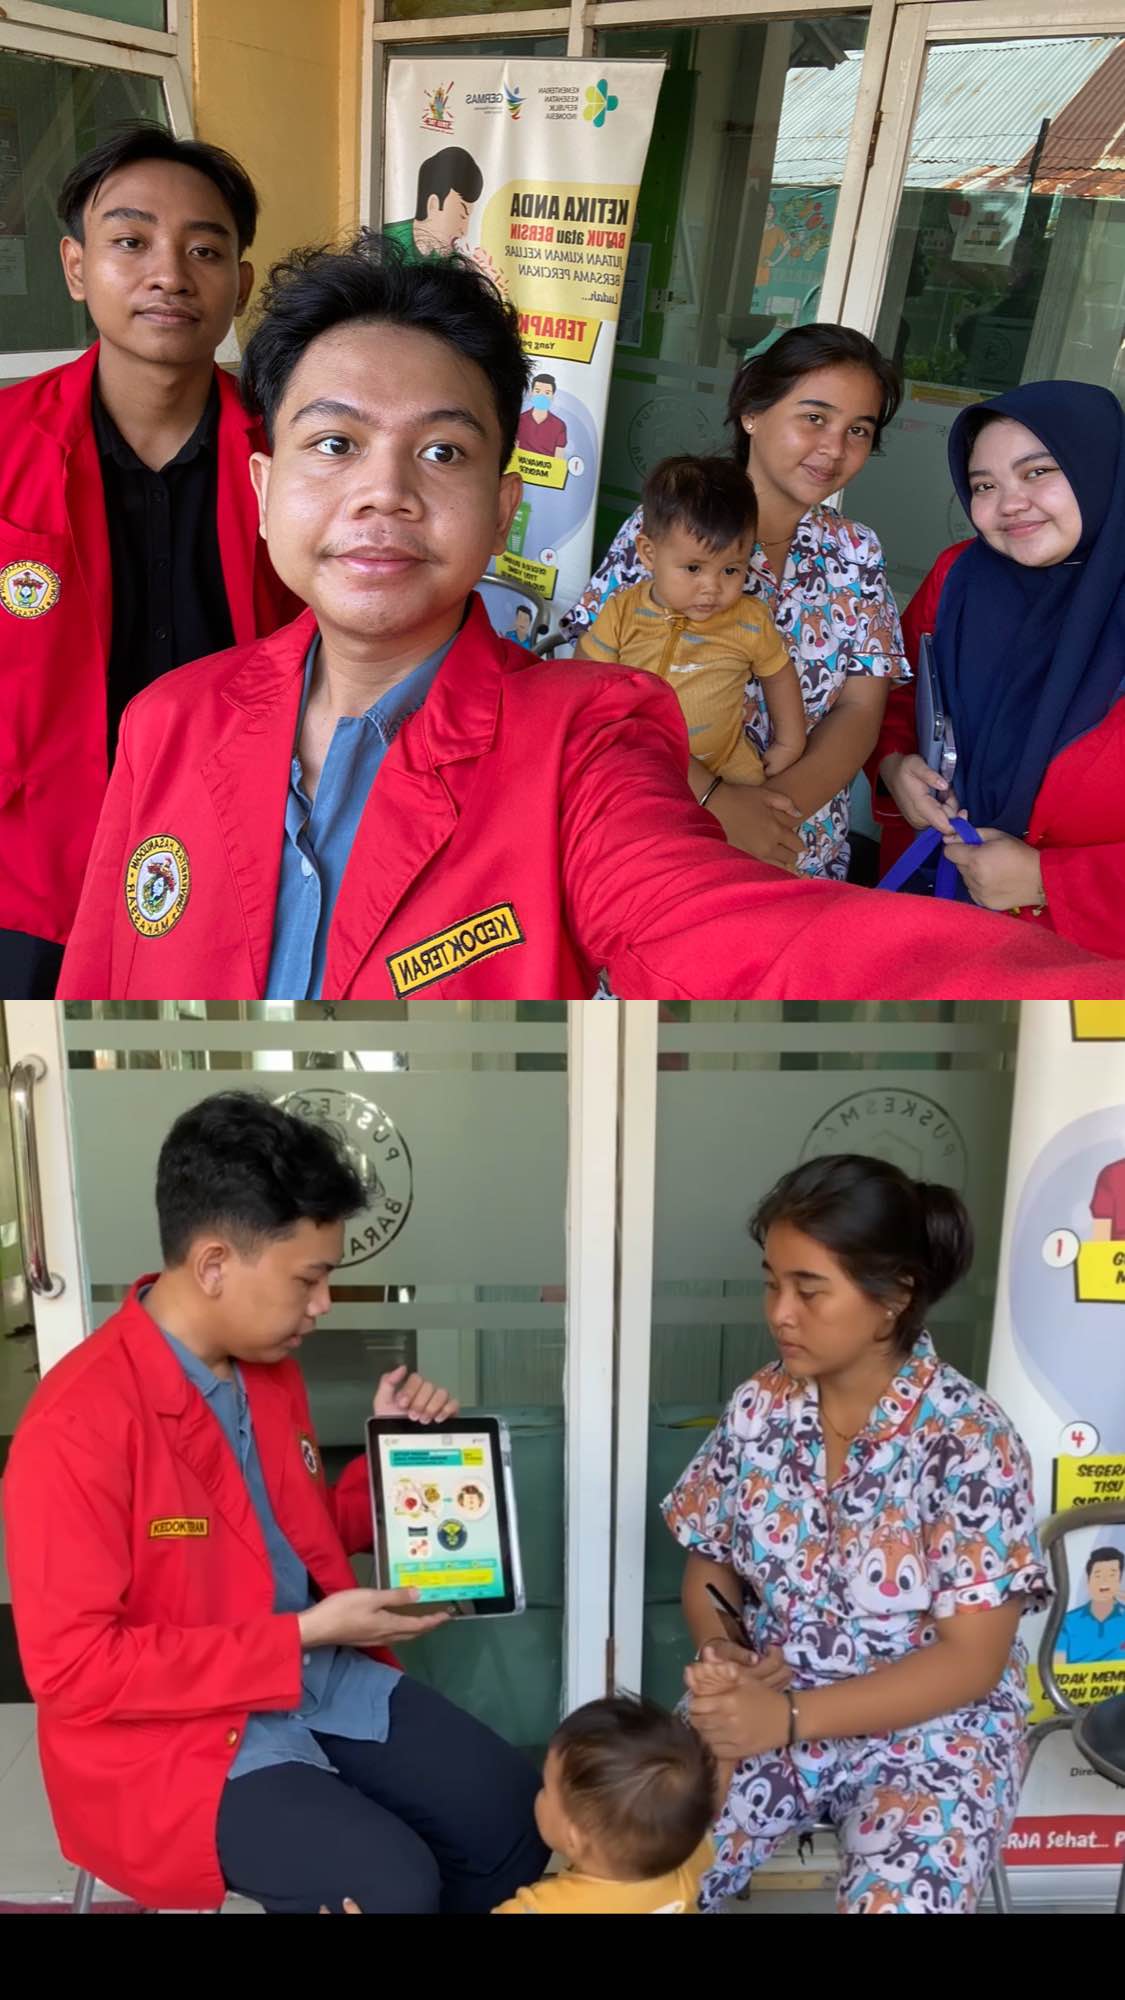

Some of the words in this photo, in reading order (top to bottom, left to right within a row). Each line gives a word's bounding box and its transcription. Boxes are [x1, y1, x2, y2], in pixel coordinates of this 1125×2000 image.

[1056, 1238, 1063, 1257] 1
[1071, 1430, 1085, 1449] 4
[1093, 1480, 1124, 1494] TISU
[1003, 1831, 1040, 1849] RJA
